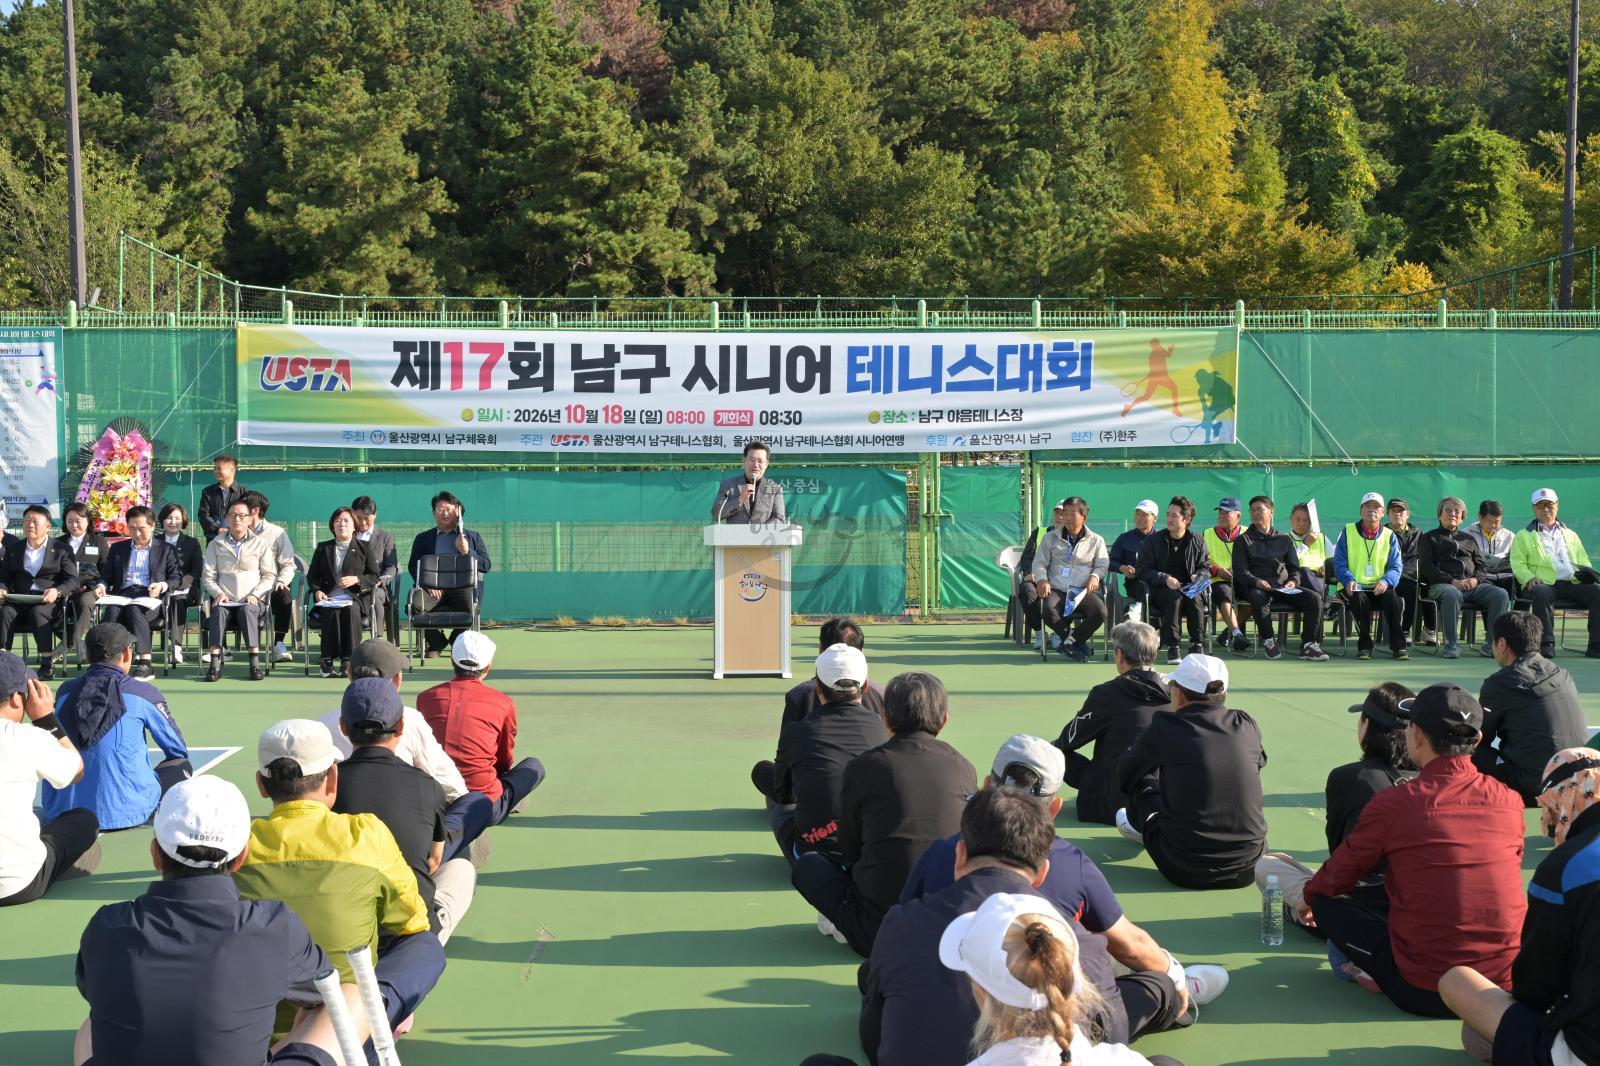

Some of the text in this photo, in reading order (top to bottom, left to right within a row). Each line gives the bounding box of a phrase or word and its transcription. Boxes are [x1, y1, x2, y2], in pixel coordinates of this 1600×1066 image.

[259, 355, 352, 392] USTA
[390, 340, 1093, 395] 제17회 남구 시니어 테니스대회
[477, 408, 503, 422] 일시
[513, 409, 561, 423] 2026년
[564, 404, 599, 424] 10월
[601, 405, 636, 424] 18일
[639, 410, 663, 424] (일)
[666, 411, 705, 424] 08:00
[716, 411, 752, 425] 개회식
[759, 410, 803, 425] 08:30
[882, 410, 908, 423] 장소
[918, 410, 944, 423] 남구
[947, 409, 1024, 423] 야음테니스장
[342, 430, 497, 445] 주최 울산광역시 남구체육회
[520, 434, 543, 446] 주관
[550, 434, 590, 447] USTA
[592, 434, 646, 447] 울산광역시
[648, 434, 726, 448] 남구테니스협회,
[784, 434, 853, 447] 남구테니스협회
[855, 434, 905, 446] 시니어연맹
[926, 433, 1052, 446] 후원 울산광역시 남구
[1071, 430, 1138, 443] 협찬 (주)한주
[801, 820, 838, 844] Trion
